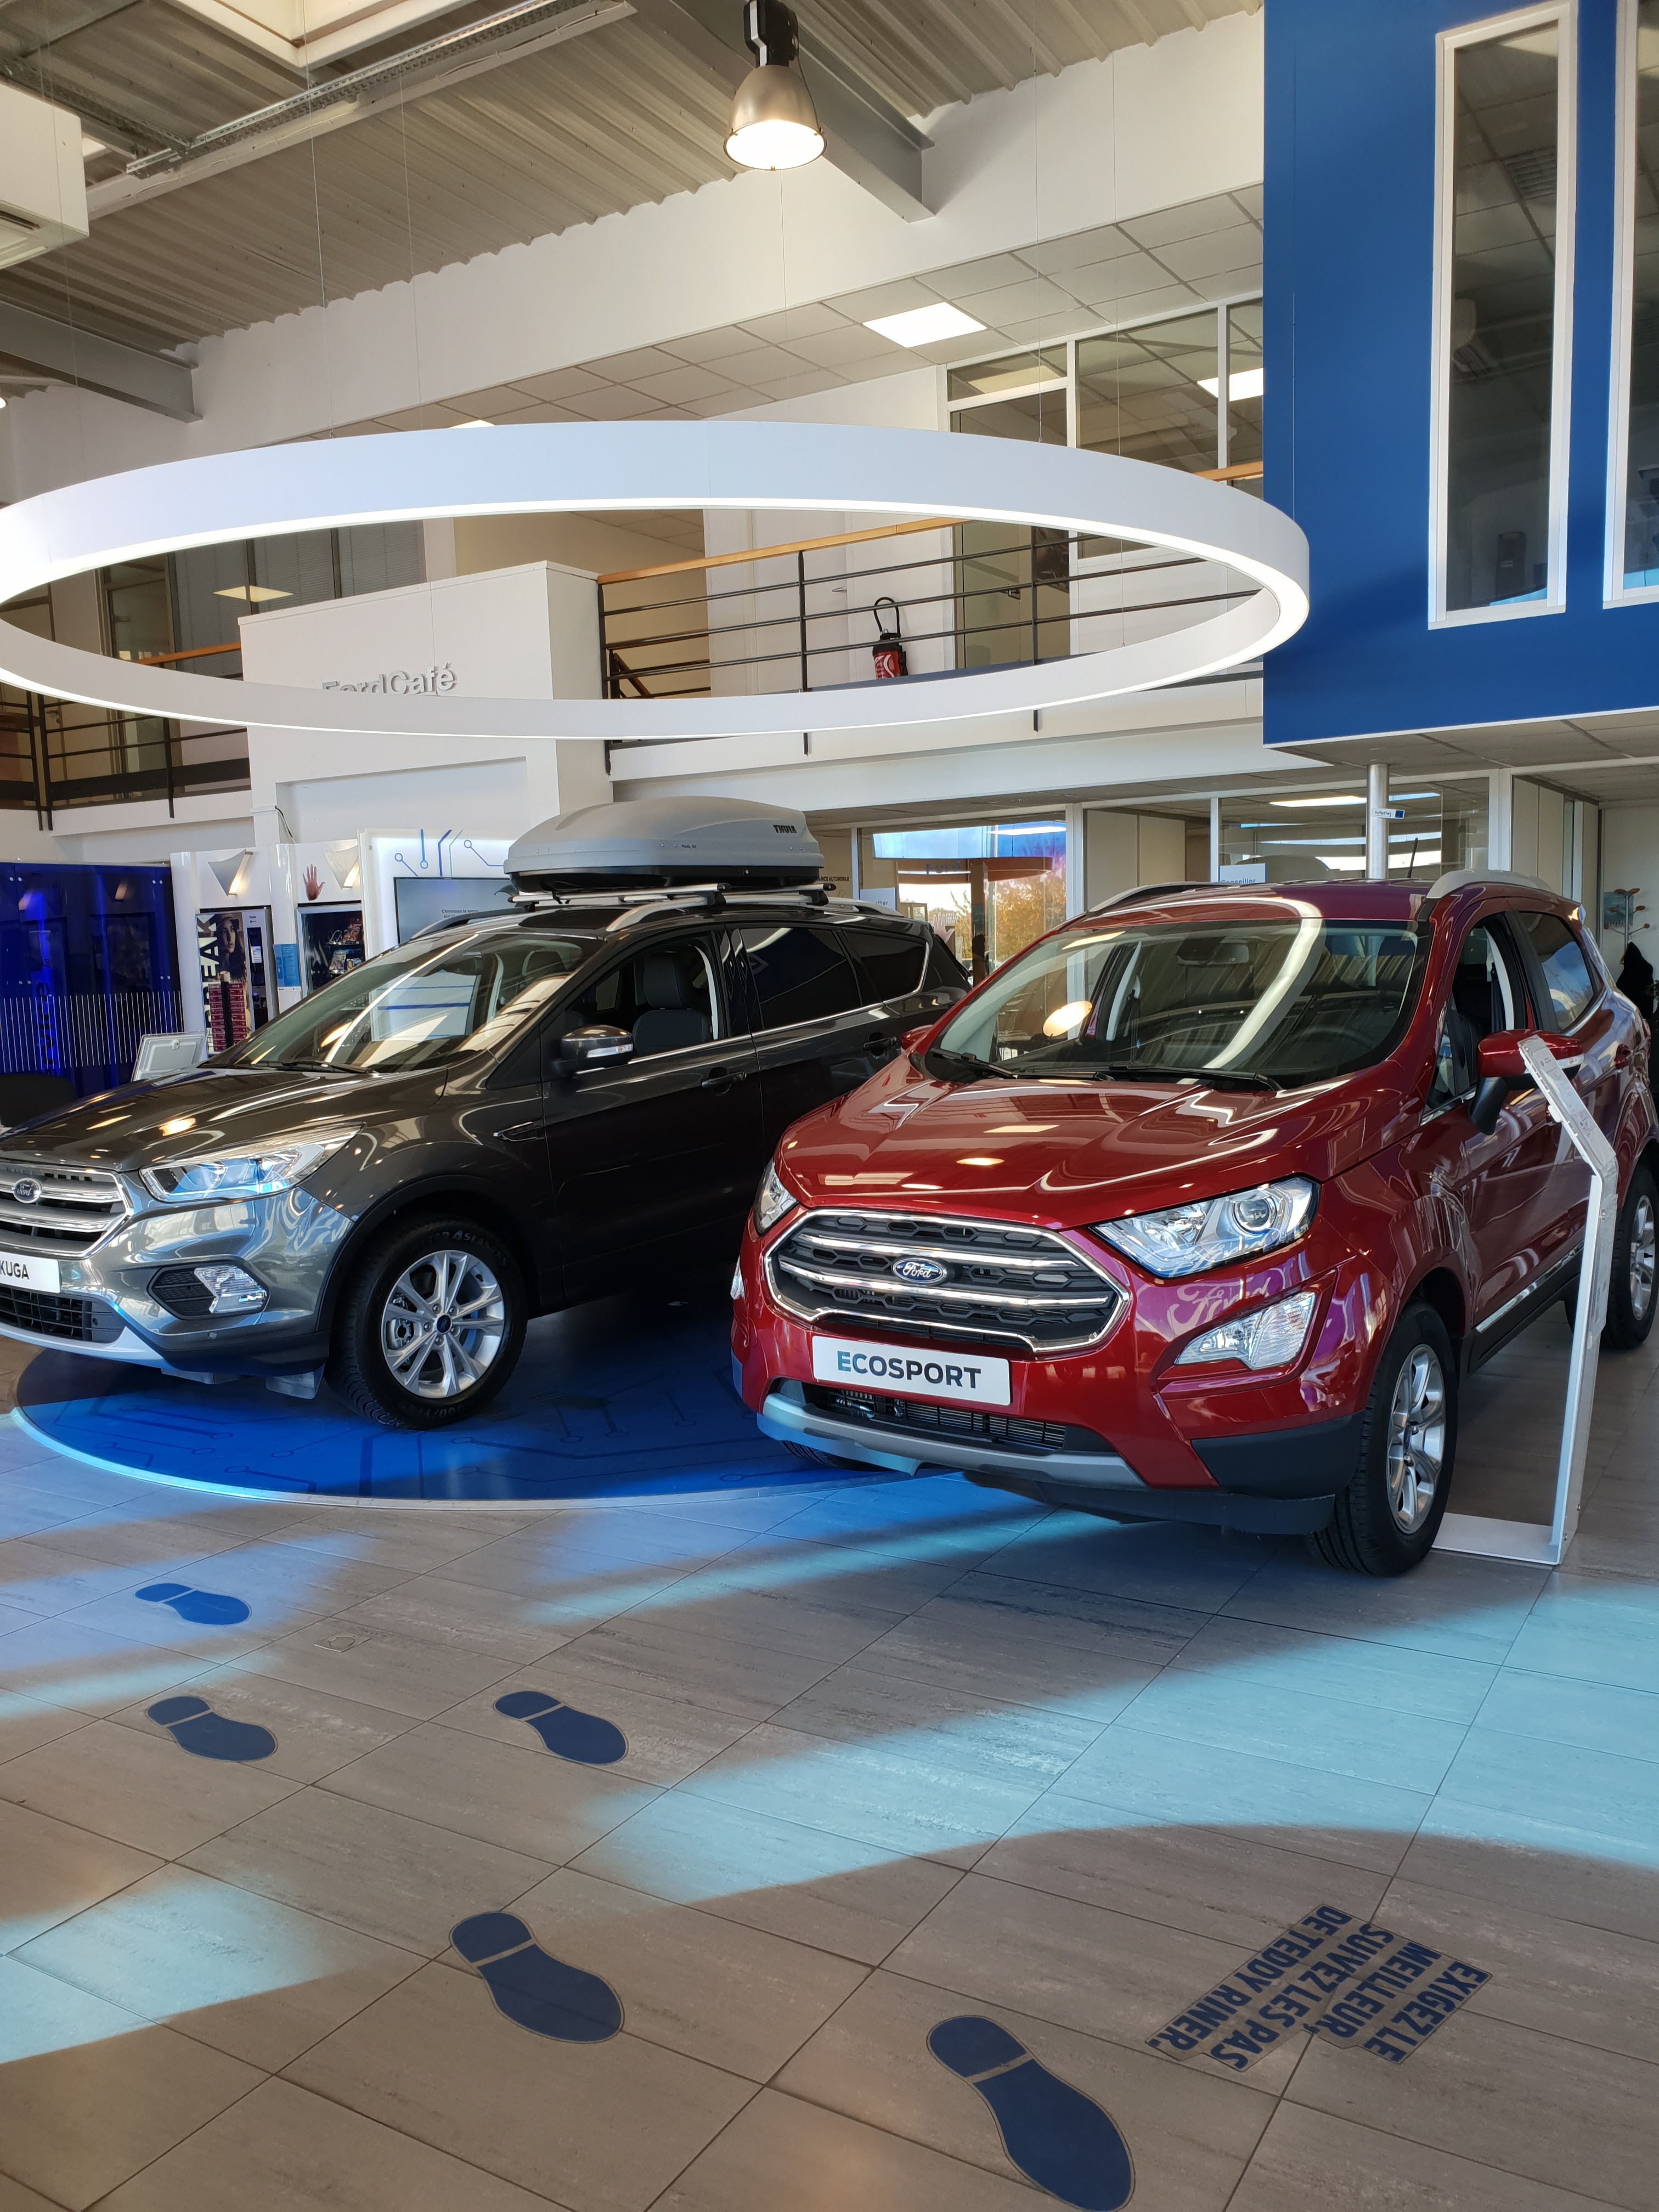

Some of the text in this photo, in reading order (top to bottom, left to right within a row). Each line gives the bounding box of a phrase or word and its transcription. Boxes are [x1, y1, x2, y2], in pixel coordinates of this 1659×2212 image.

[0, 1260, 30, 1280] KUGA
[902, 1262, 932, 1278] Ford
[837, 1350, 981, 1389] ECOSPORT
[1149, 1907, 1352, 2051] DE TEDDY RINER.
[1211, 1924, 1394, 2069] SUIVEZ LES PAS
[1303, 1942, 1441, 2038] MEILLEUR,
[1364, 1962, 1488, 2062] EXIGEZ LE
